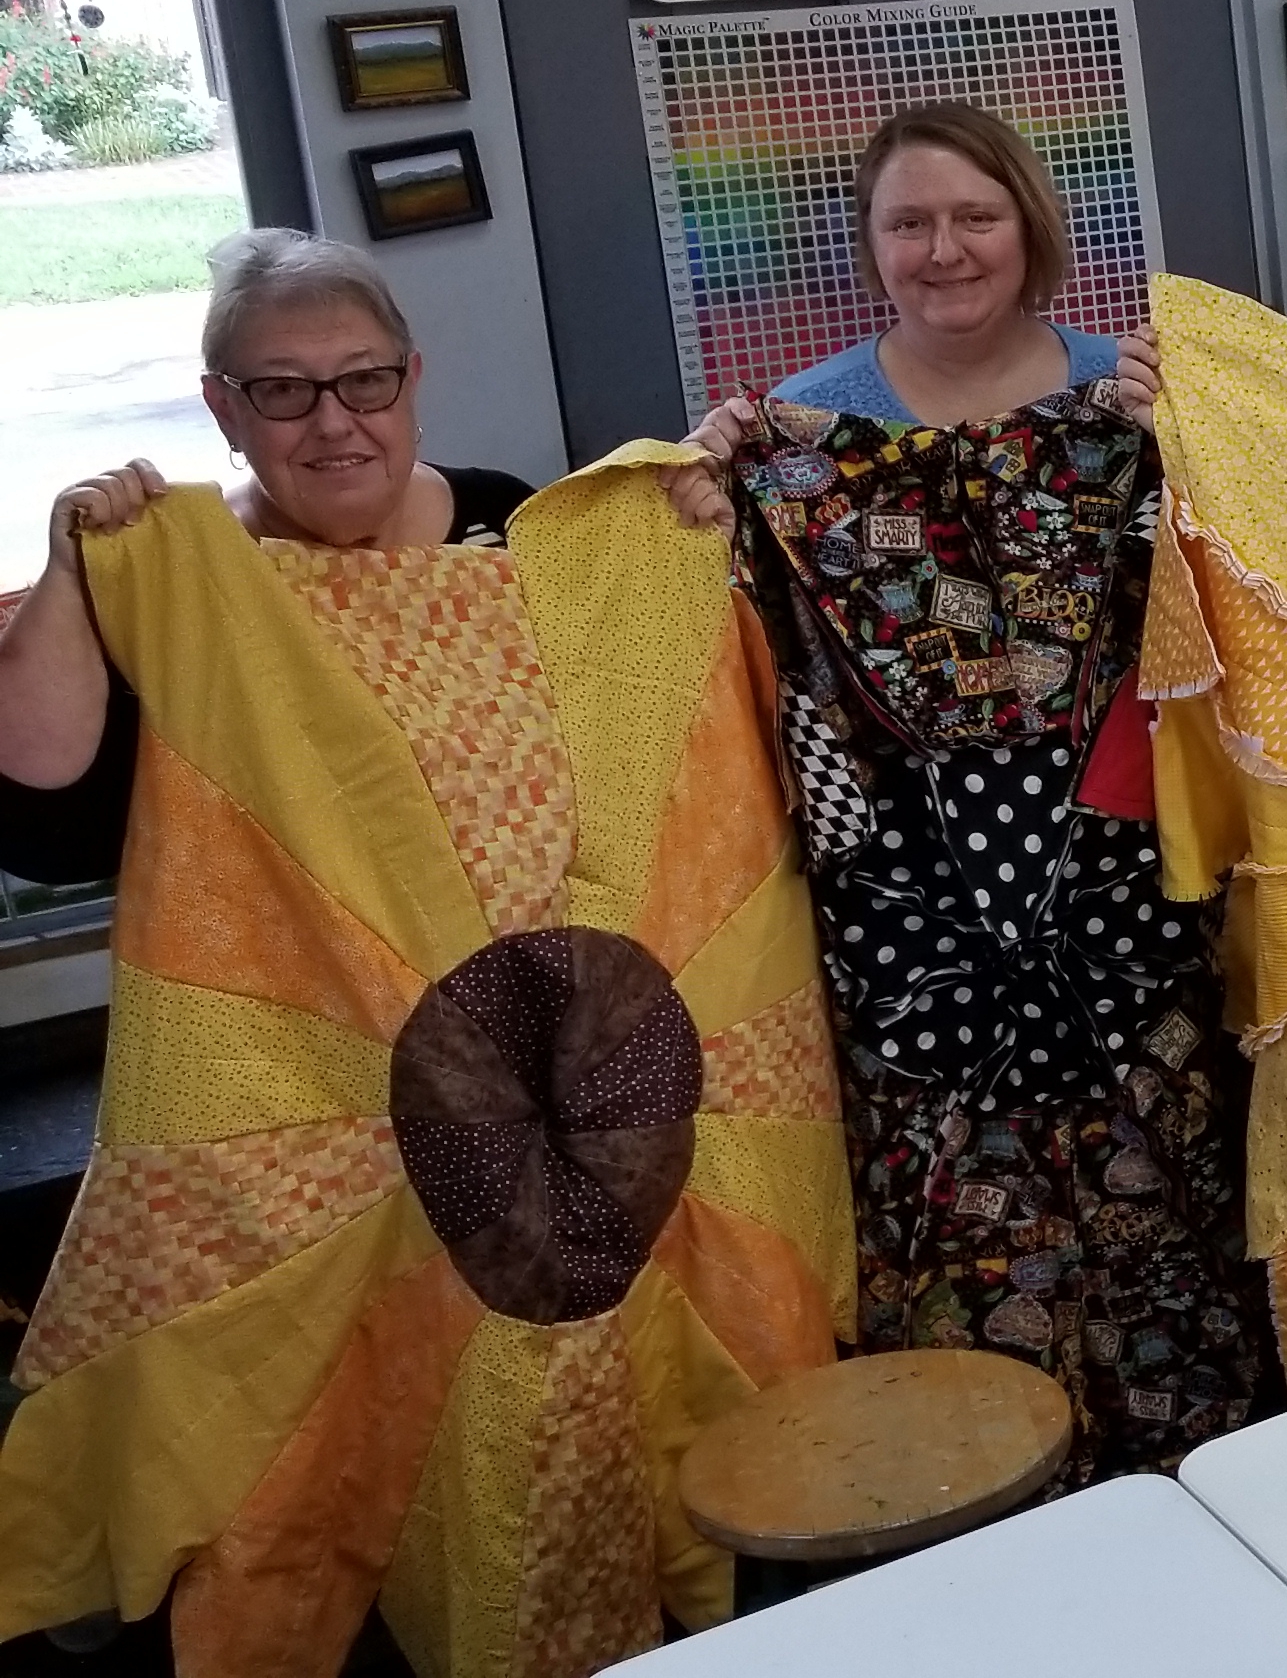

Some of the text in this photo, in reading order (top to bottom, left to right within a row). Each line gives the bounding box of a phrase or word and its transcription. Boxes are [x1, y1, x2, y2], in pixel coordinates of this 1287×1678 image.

[809, 4, 977, 27] COLOR MIXING GUIDE
[658, 21, 705, 36] MAGIC
[884, 518, 907, 530] MISS
[874, 529, 918, 546] SMARTY
